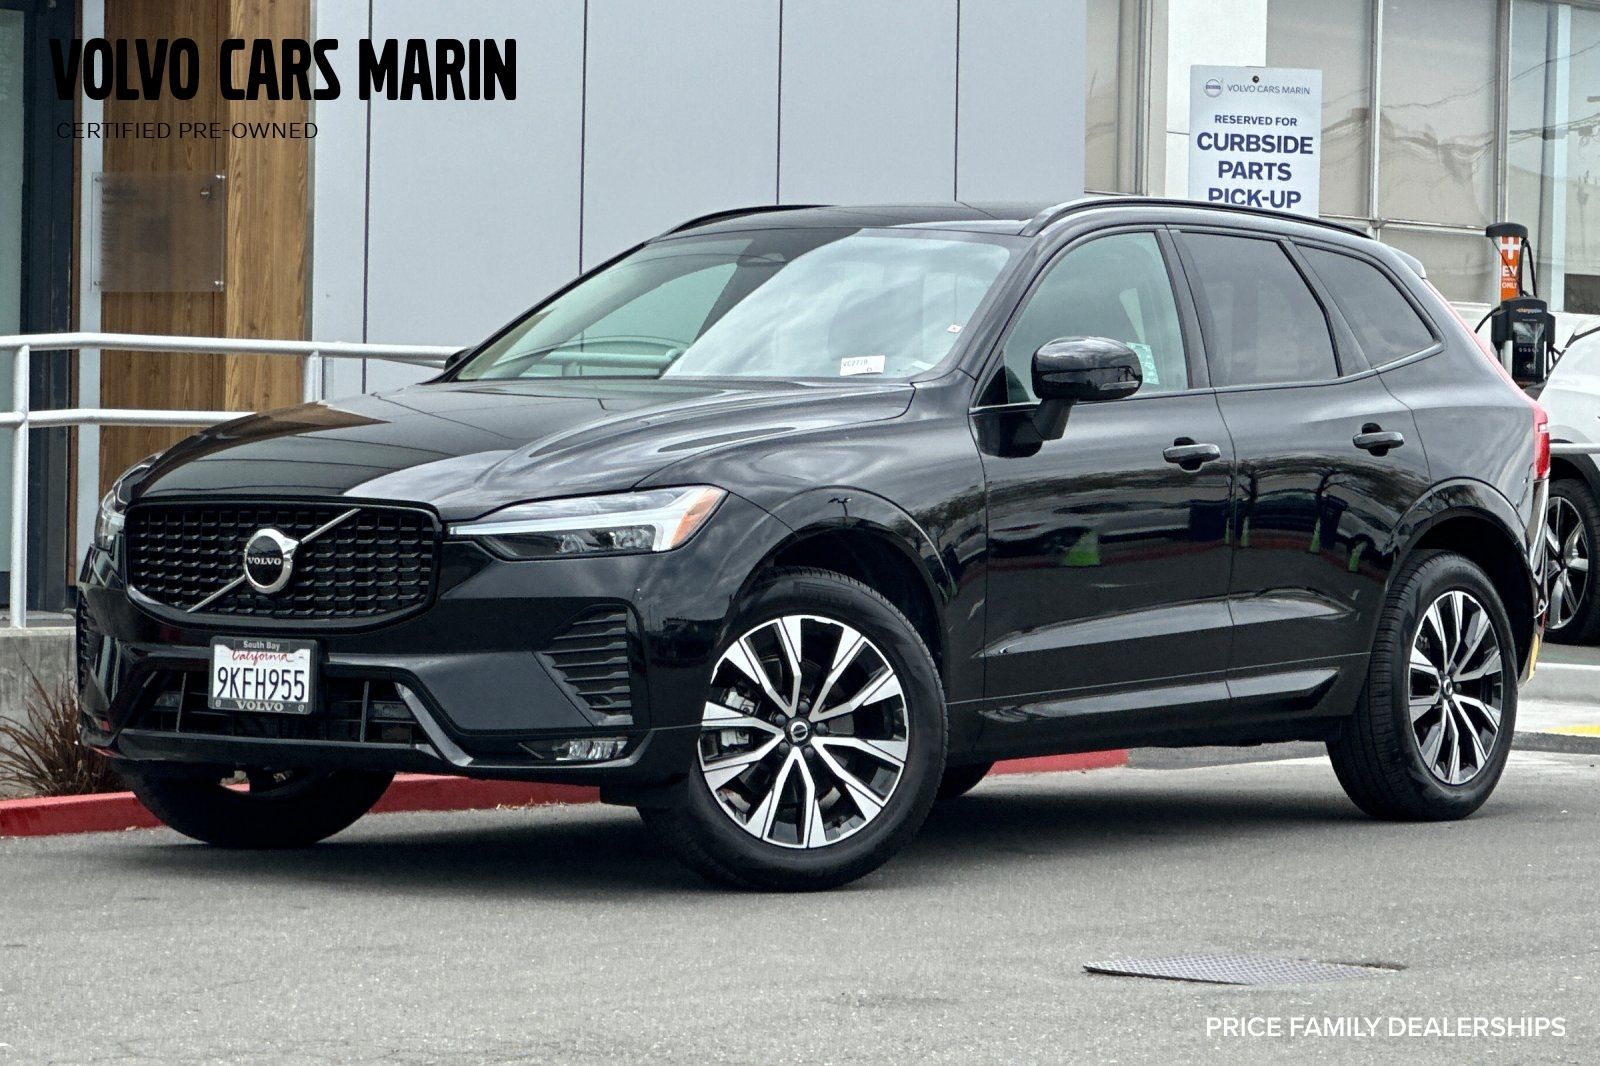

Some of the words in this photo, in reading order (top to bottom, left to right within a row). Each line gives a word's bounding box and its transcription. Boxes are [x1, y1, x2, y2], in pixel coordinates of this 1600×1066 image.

[1227, 84, 1256, 93] VOLVO
[1257, 85, 1280, 94] CARS
[1282, 86, 1311, 95] MARIN
[1214, 115, 1273, 126] RESERVED
[1275, 117, 1298, 126] FOR
[1197, 132, 1314, 154] CURBSIDE
[1218, 160, 1292, 181] PARTS
[1208, 187, 1302, 209] PICK-UP
[1502, 265, 1518, 277] EV
[1501, 281, 1517, 289] ONLY
[247, 557, 282, 565] VOLVO
[243, 640, 265, 649] South
[266, 641, 281, 652] Bay
[232, 650, 294, 666] California
[217, 666, 305, 701] 9KFH955
[235, 700, 284, 712] VOLVO
